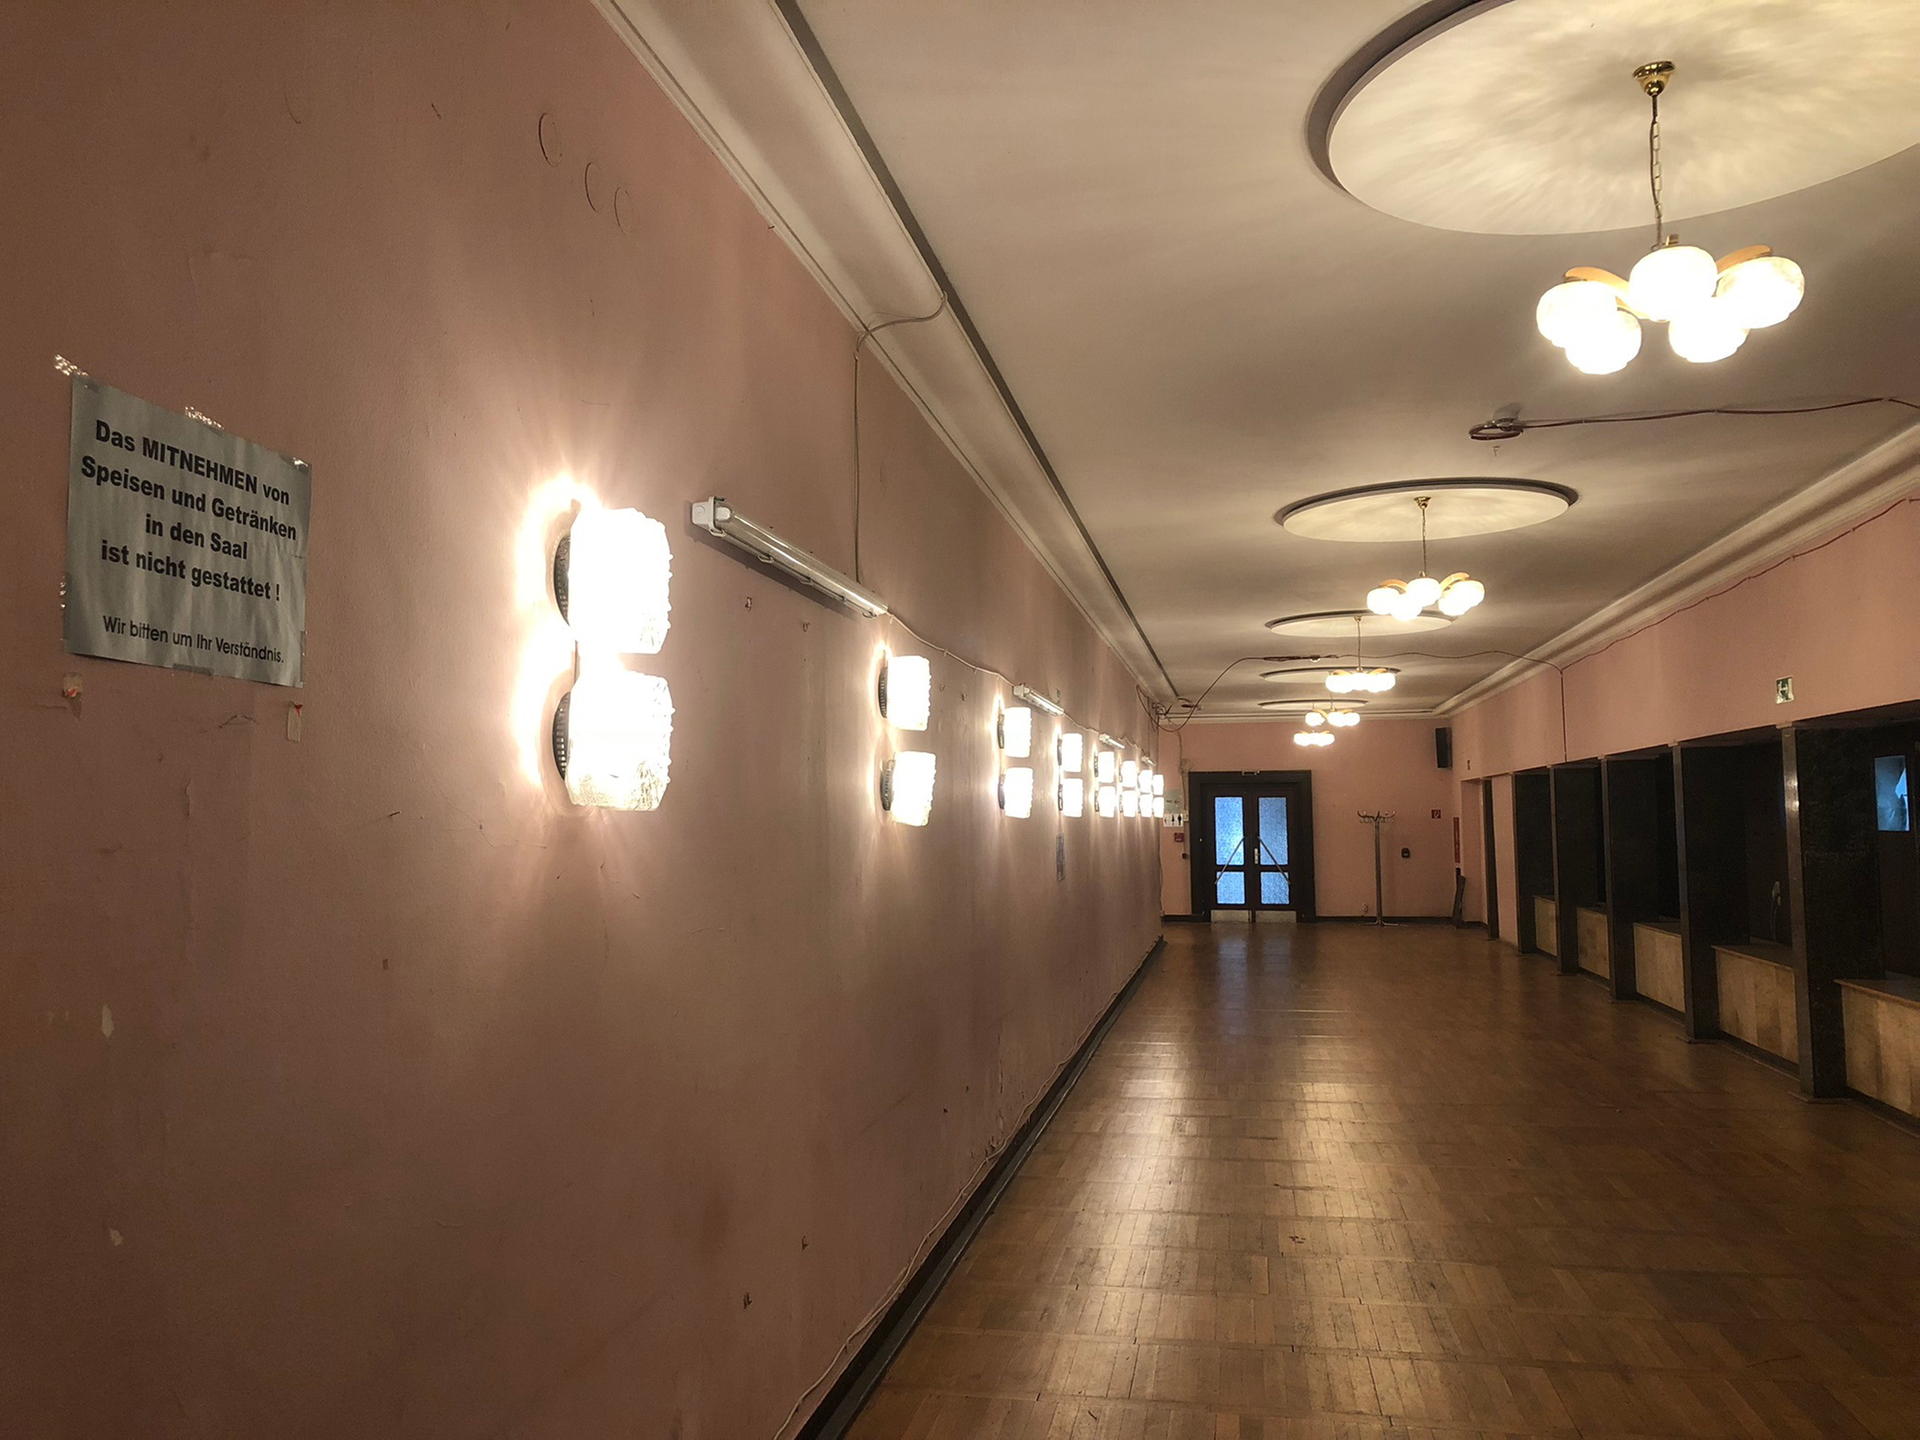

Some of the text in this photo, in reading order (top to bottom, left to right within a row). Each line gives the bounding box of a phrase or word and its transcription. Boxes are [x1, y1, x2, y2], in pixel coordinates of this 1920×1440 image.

[96, 420, 289, 505] Das MITNEHMEN von
[81, 456, 296, 540] Speisen und Getränken
[146, 514, 247, 559] in den Saal
[101, 540, 279, 600] ist nicht gestattet !
[103, 616, 284, 663] Wir bitten um Ihr Verständnis.
